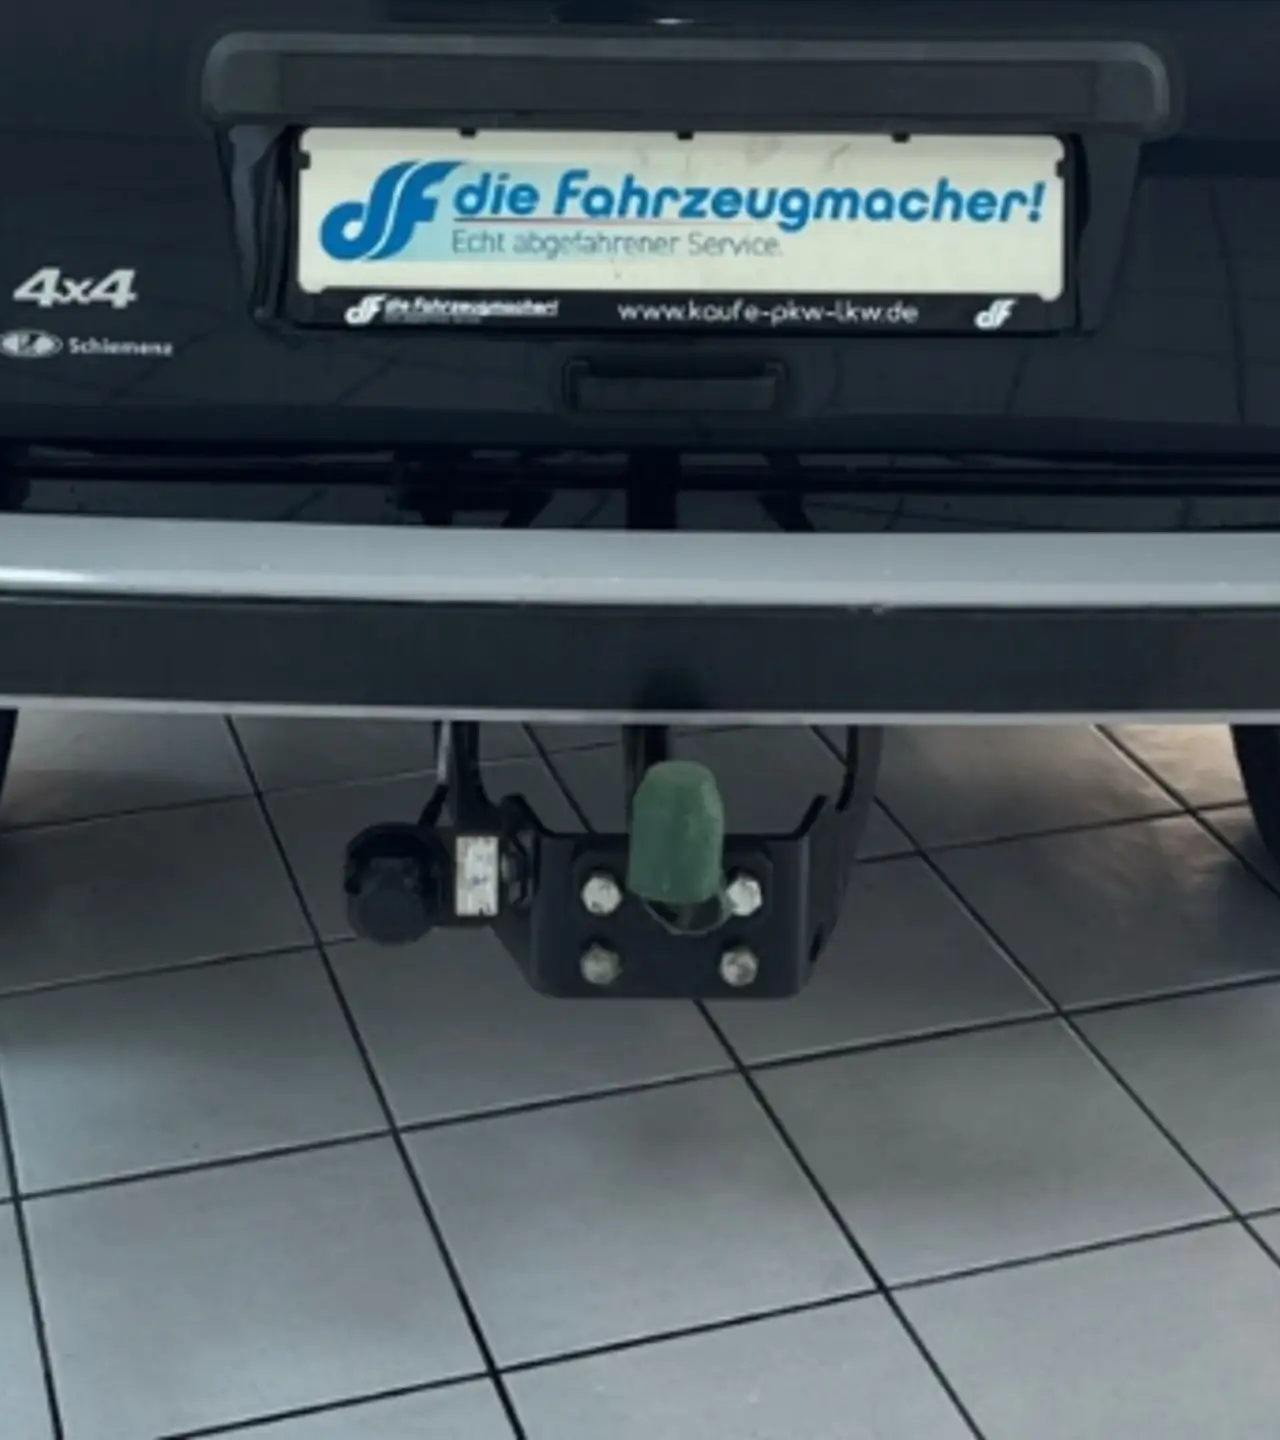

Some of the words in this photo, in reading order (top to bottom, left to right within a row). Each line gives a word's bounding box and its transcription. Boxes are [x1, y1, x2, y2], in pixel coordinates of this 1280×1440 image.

[454, 170, 540, 216] die
[554, 170, 1046, 232] Fahrzeugmacher!
[453, 229, 507, 256] Echt
[513, 231, 680, 260] abgefahrener
[12, 266, 138, 309] 4x4
